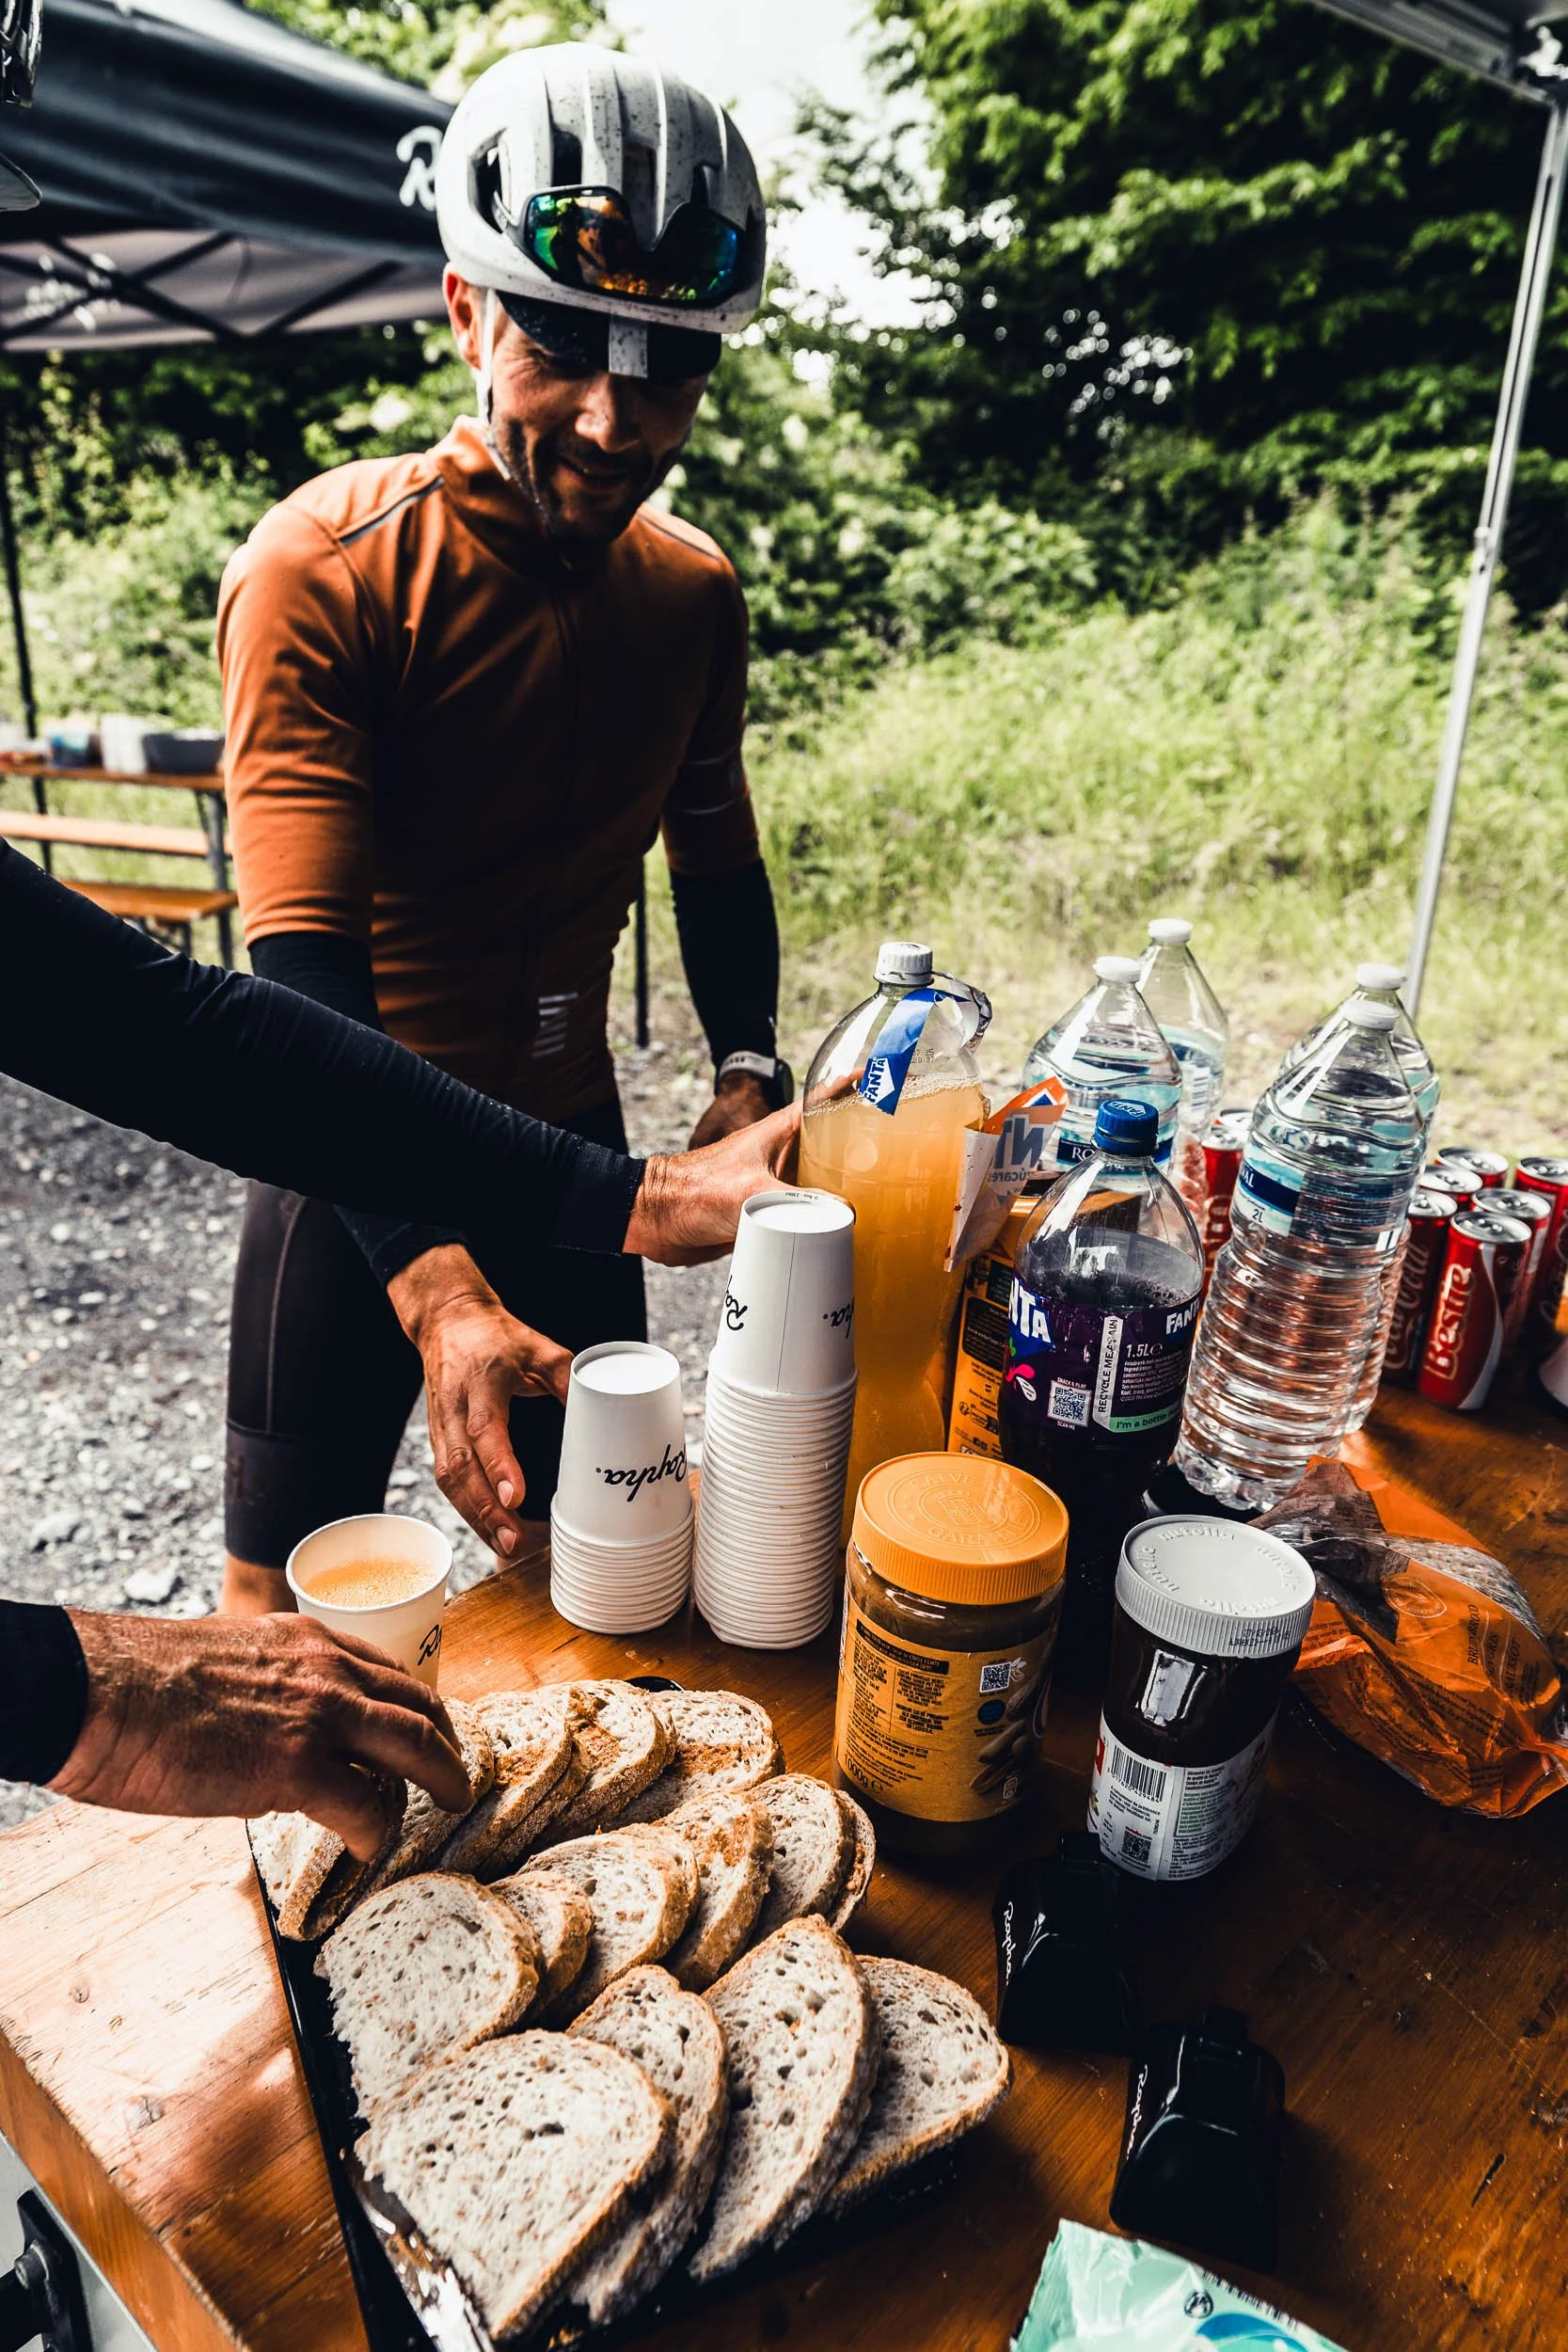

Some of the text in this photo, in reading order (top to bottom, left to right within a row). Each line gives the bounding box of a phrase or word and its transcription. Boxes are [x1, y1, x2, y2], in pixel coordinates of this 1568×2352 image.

[863, 1057, 887, 1104] FANTA
[1252, 1209, 1264, 1223] 2L
[1104, 1352, 1114, 1368] ME
[1098, 1371, 1111, 1413] RECYCLE
[845, 1754, 869, 1788] 1000g
